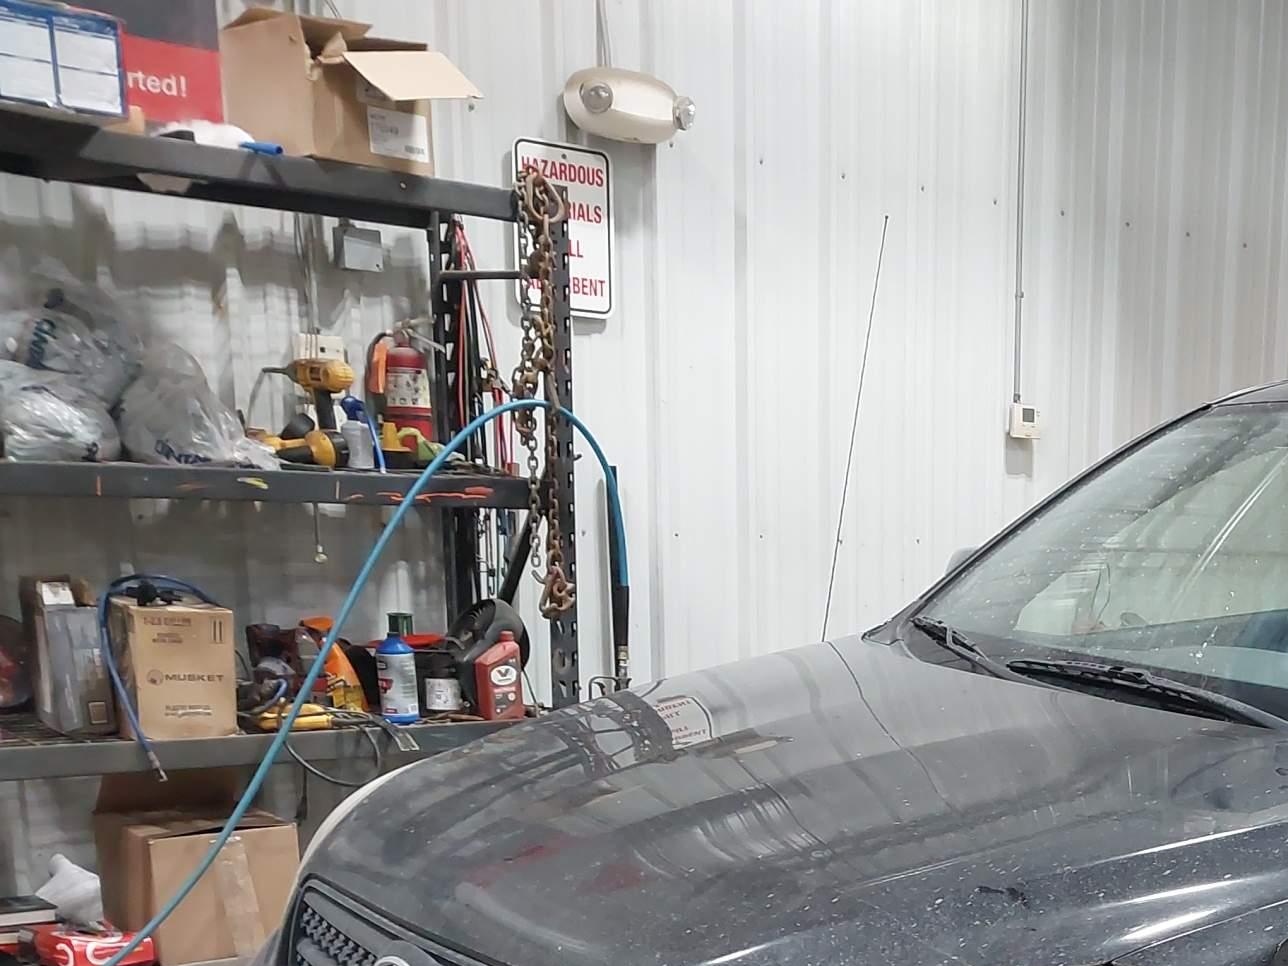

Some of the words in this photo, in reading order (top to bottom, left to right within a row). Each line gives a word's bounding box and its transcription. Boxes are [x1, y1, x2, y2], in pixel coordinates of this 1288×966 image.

[126, 70, 187, 97] rted!
[567, 201, 602, 224] RIALS
[164, 673, 224, 682] MUSKET
